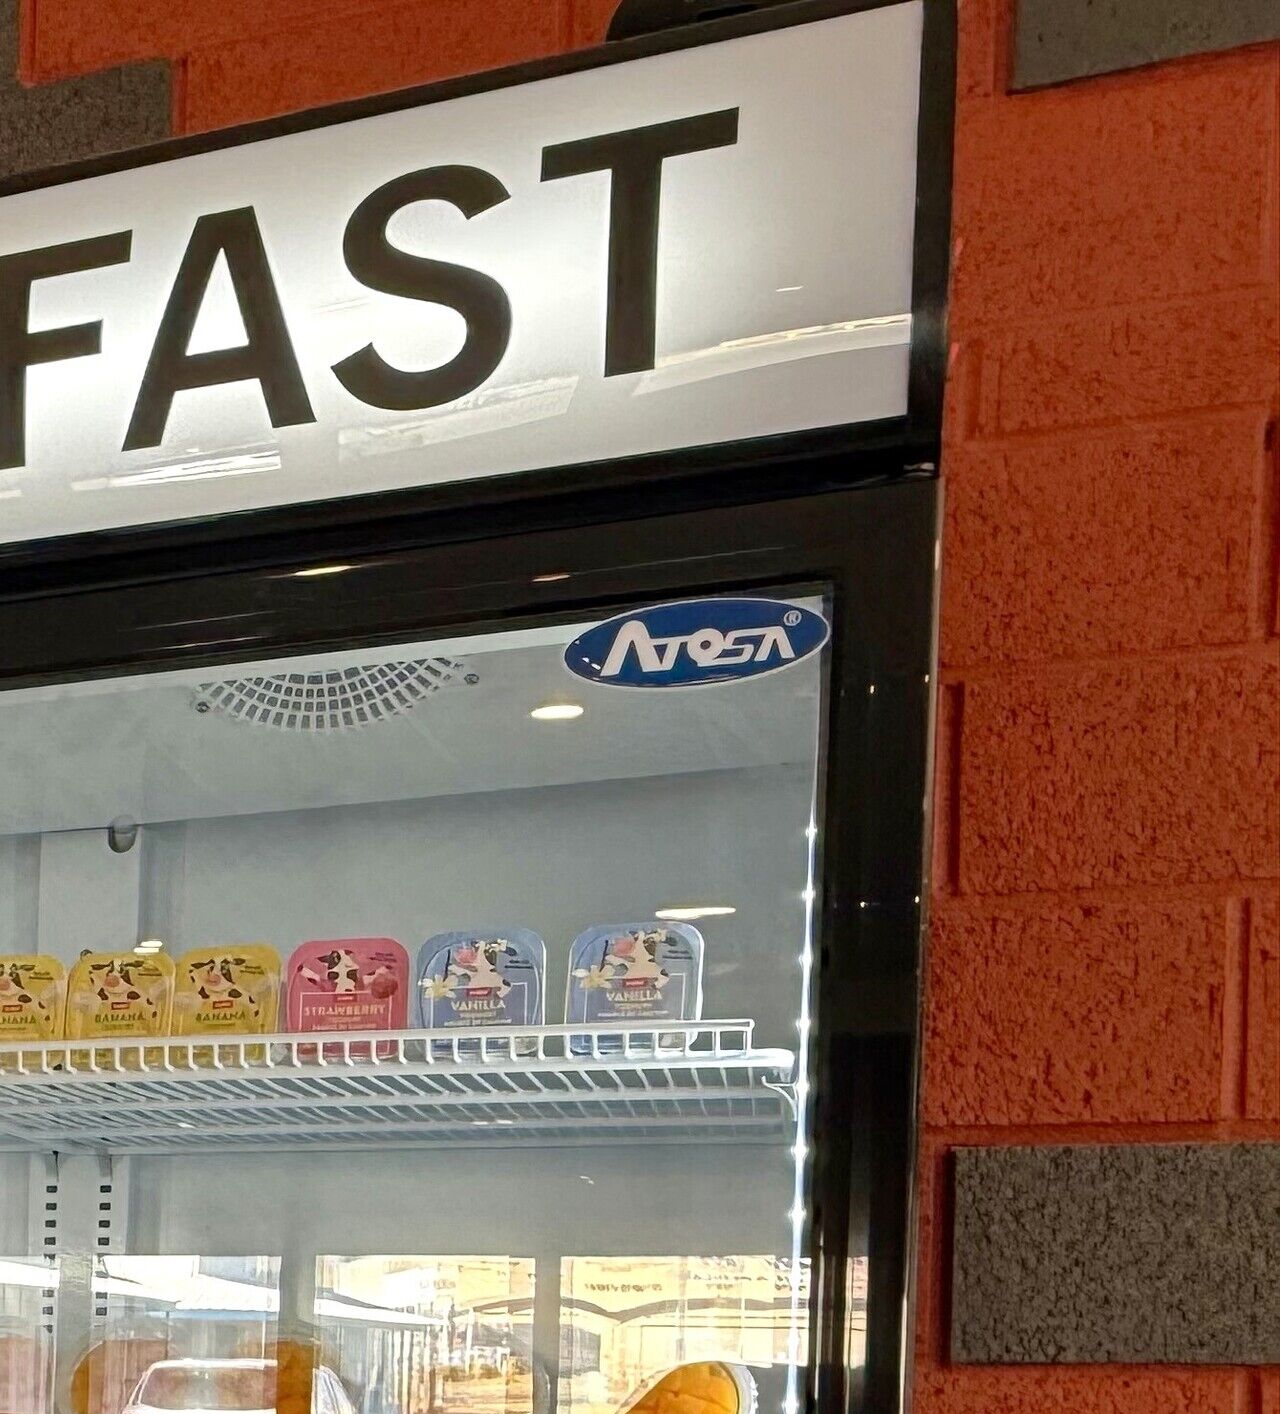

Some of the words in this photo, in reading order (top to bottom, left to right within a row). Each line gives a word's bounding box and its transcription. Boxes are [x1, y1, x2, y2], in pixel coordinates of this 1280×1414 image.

[607, 988, 663, 1002] VANILLA
[304, 1003, 386, 1016] STRAWBERRY
[451, 999, 507, 1011] VANILLA
